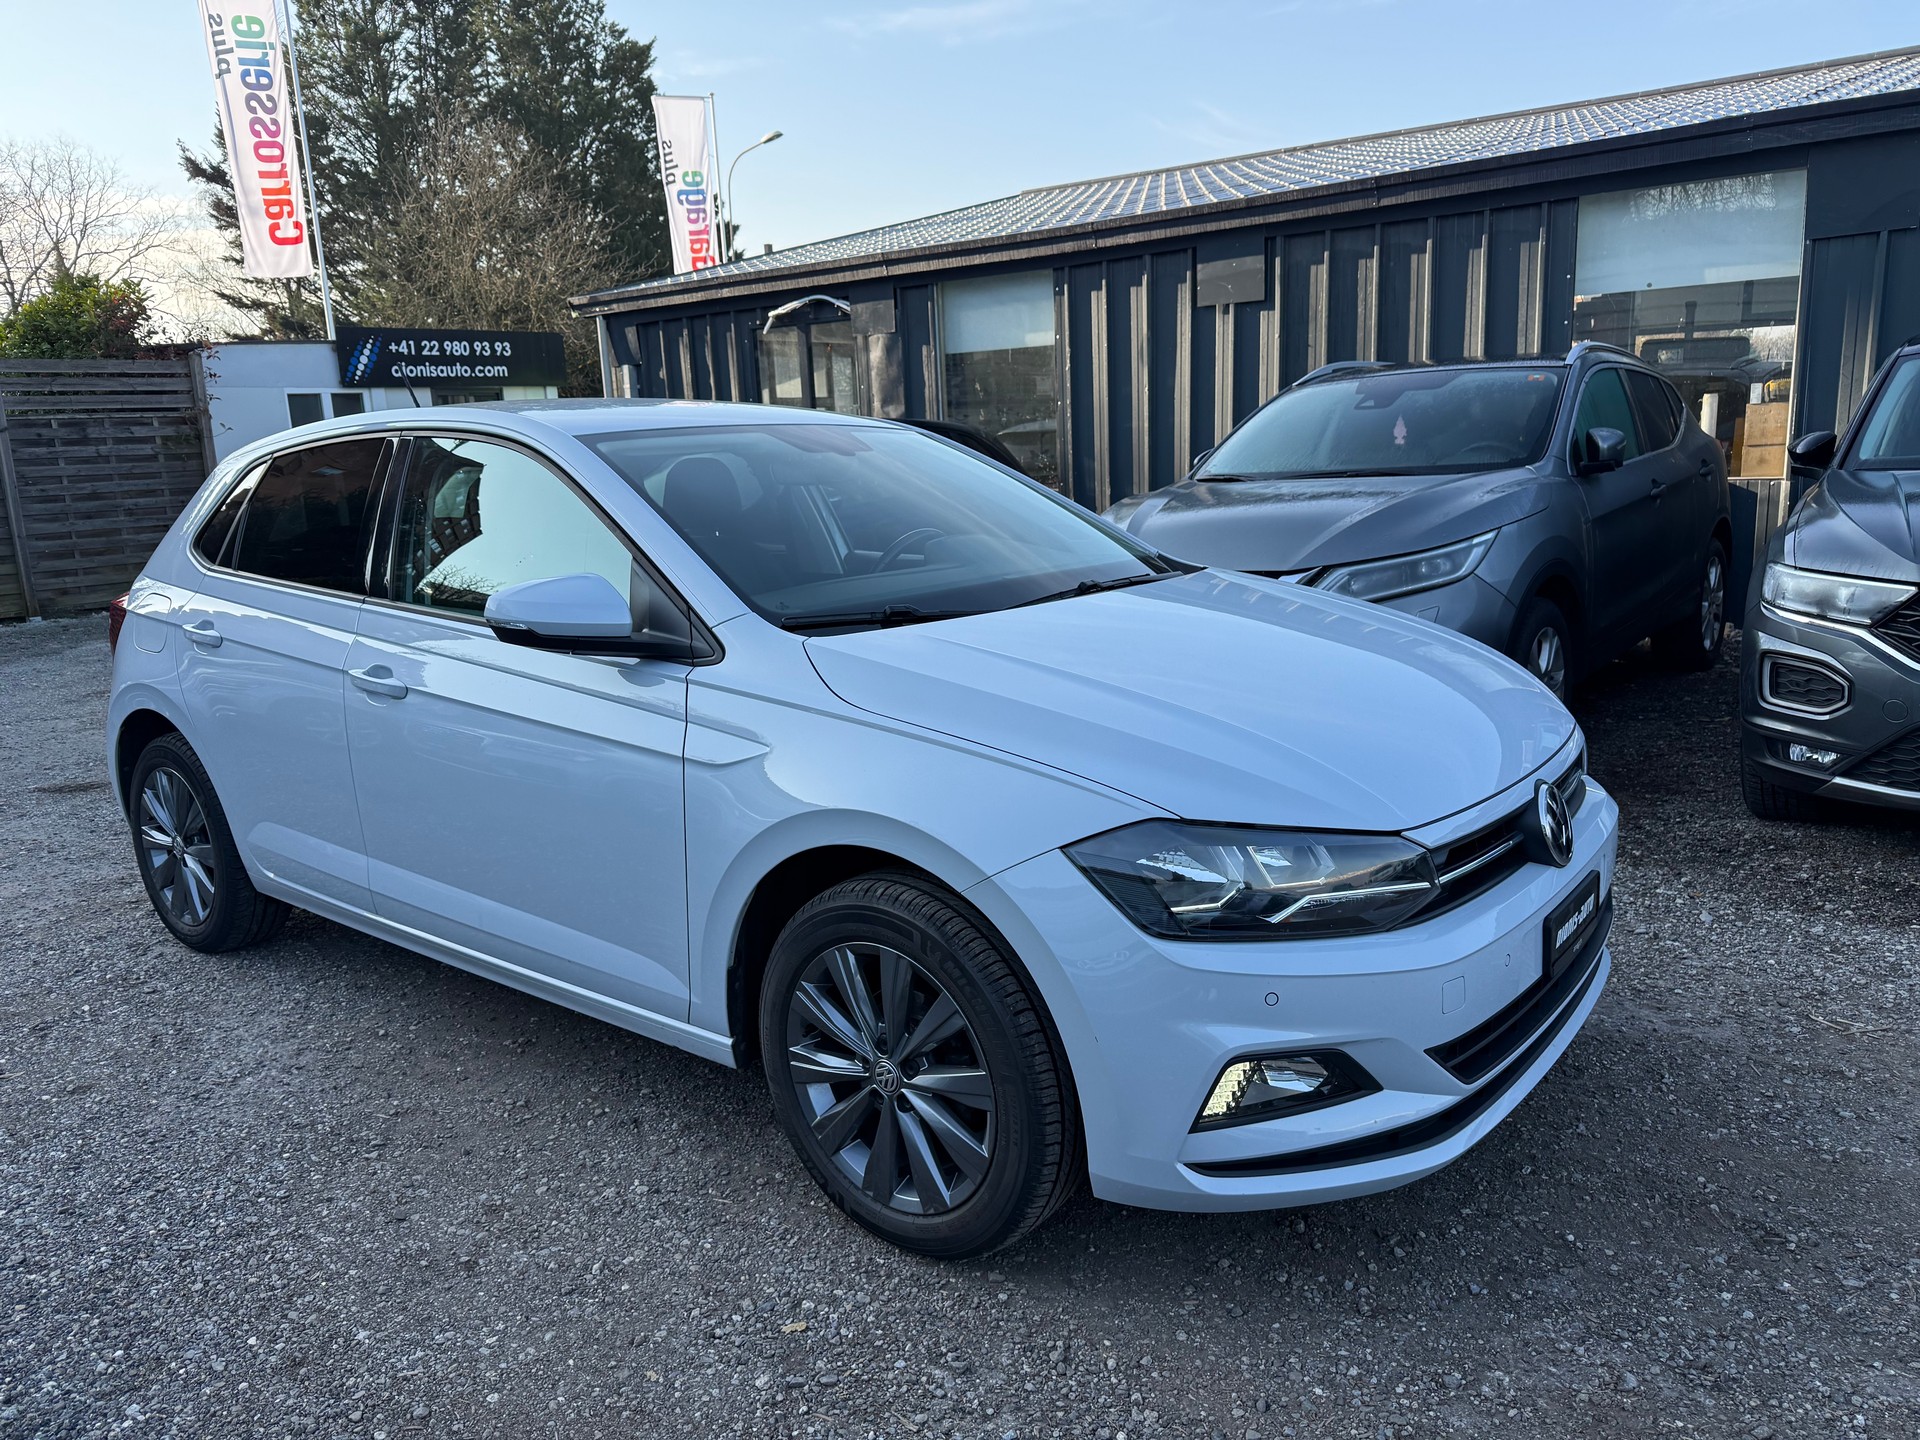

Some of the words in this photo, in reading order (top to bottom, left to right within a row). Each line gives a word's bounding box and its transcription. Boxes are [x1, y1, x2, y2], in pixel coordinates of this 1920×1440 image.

[388, 340, 416, 356] +41
[421, 340, 440, 356] 22
[443, 340, 470, 356] 980
[473, 341, 491, 357] 93
[494, 341, 512, 357] 93
